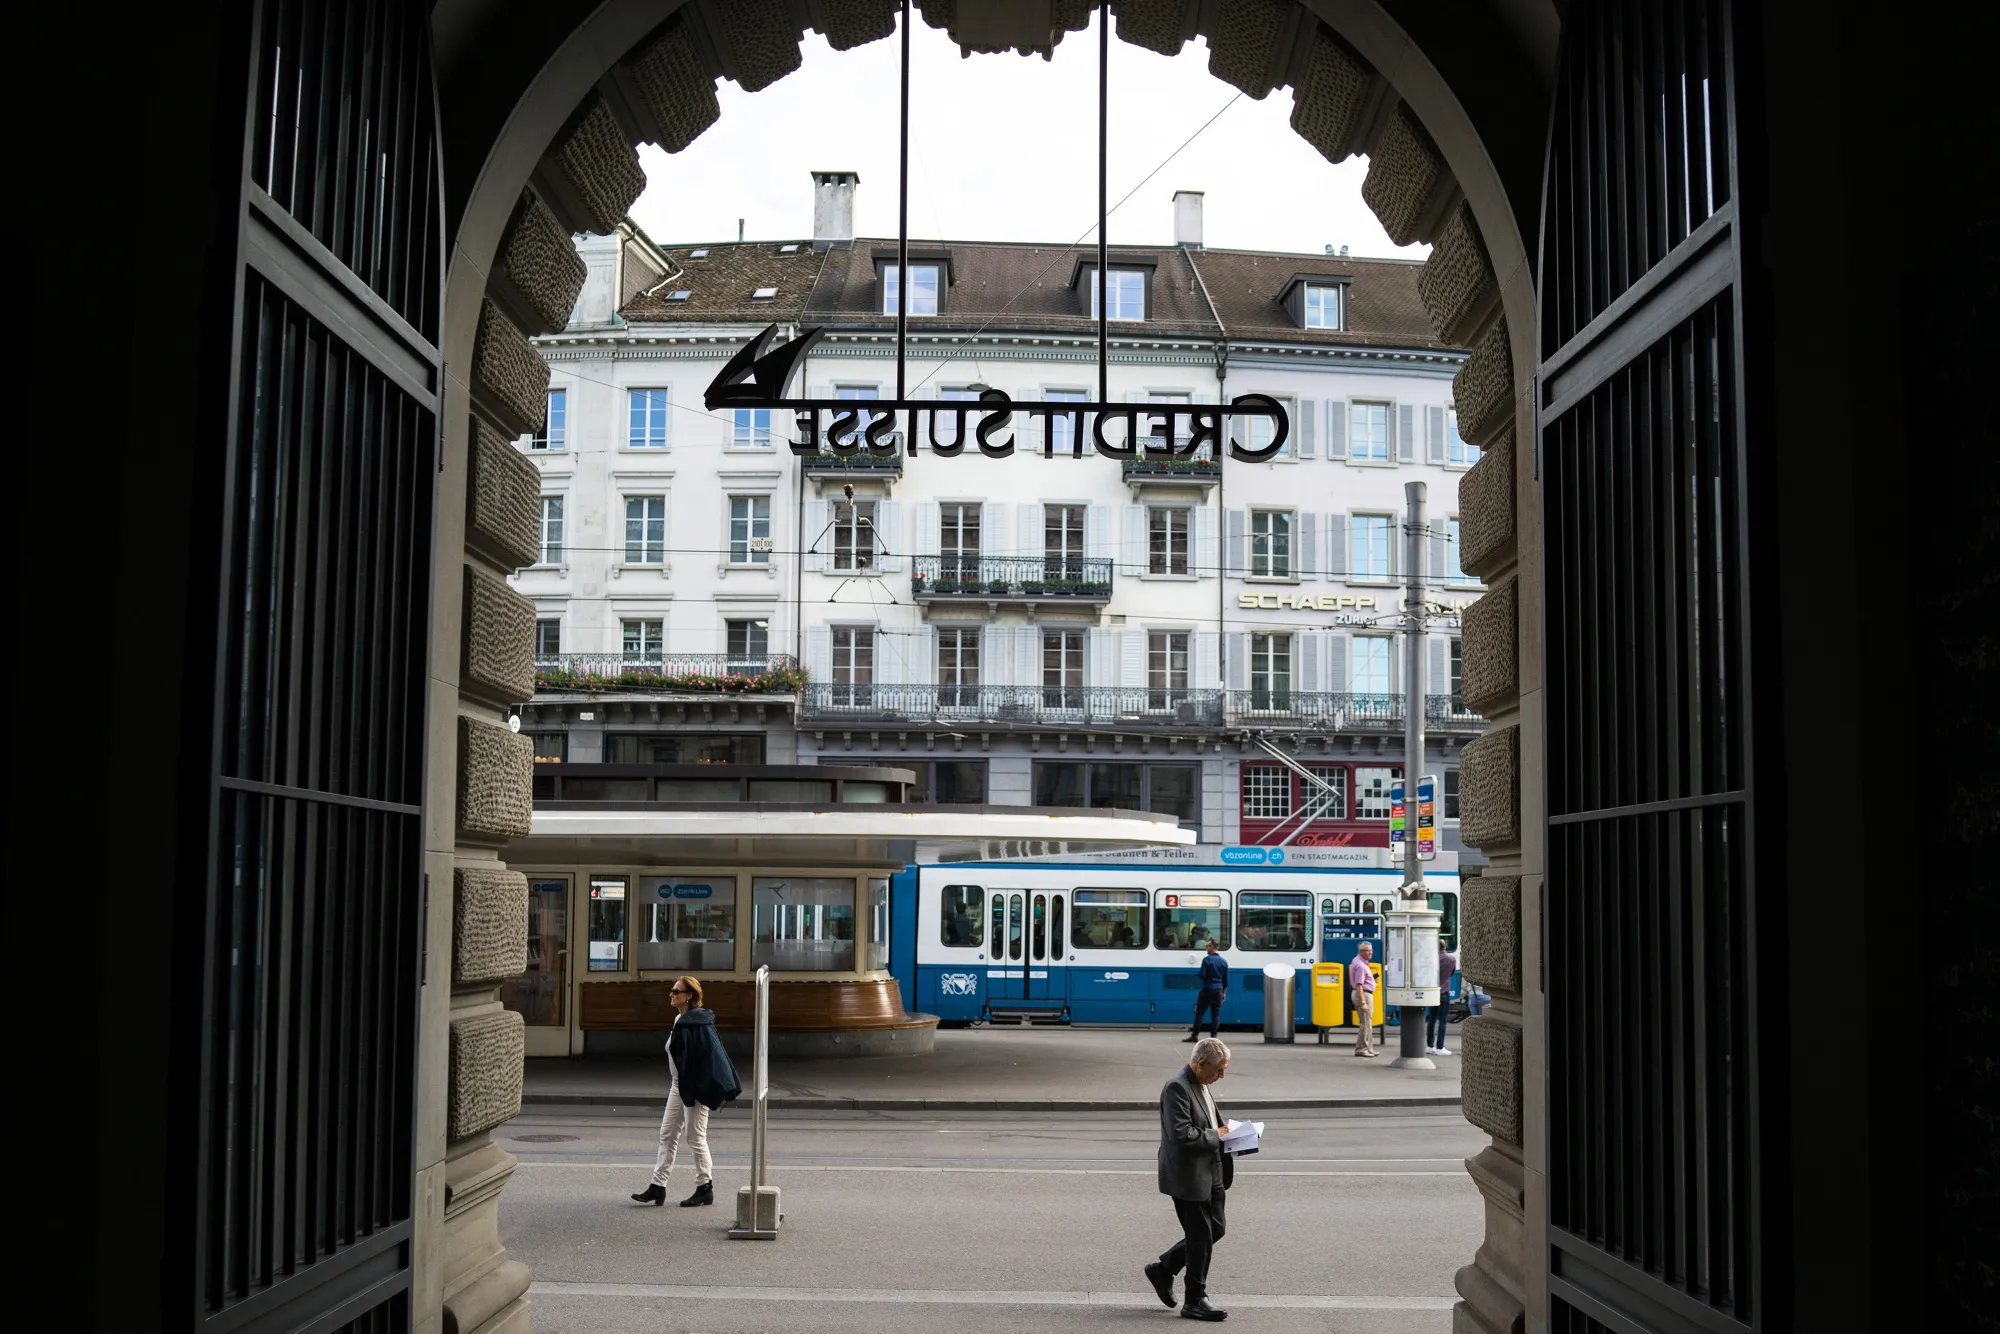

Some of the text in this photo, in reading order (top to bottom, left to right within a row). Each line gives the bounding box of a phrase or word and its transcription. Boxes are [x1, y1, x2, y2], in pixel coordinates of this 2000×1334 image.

[1238, 591, 1381, 612] SCHAEPPI
[1151, 850, 1160, 858] &
[1164, 849, 1198, 858] Teilen.
[1224, 852, 1263, 860] vbzonline
[1307, 853, 1371, 861] STADTMAGAZIN.
[1168, 896, 1176, 906] 2
